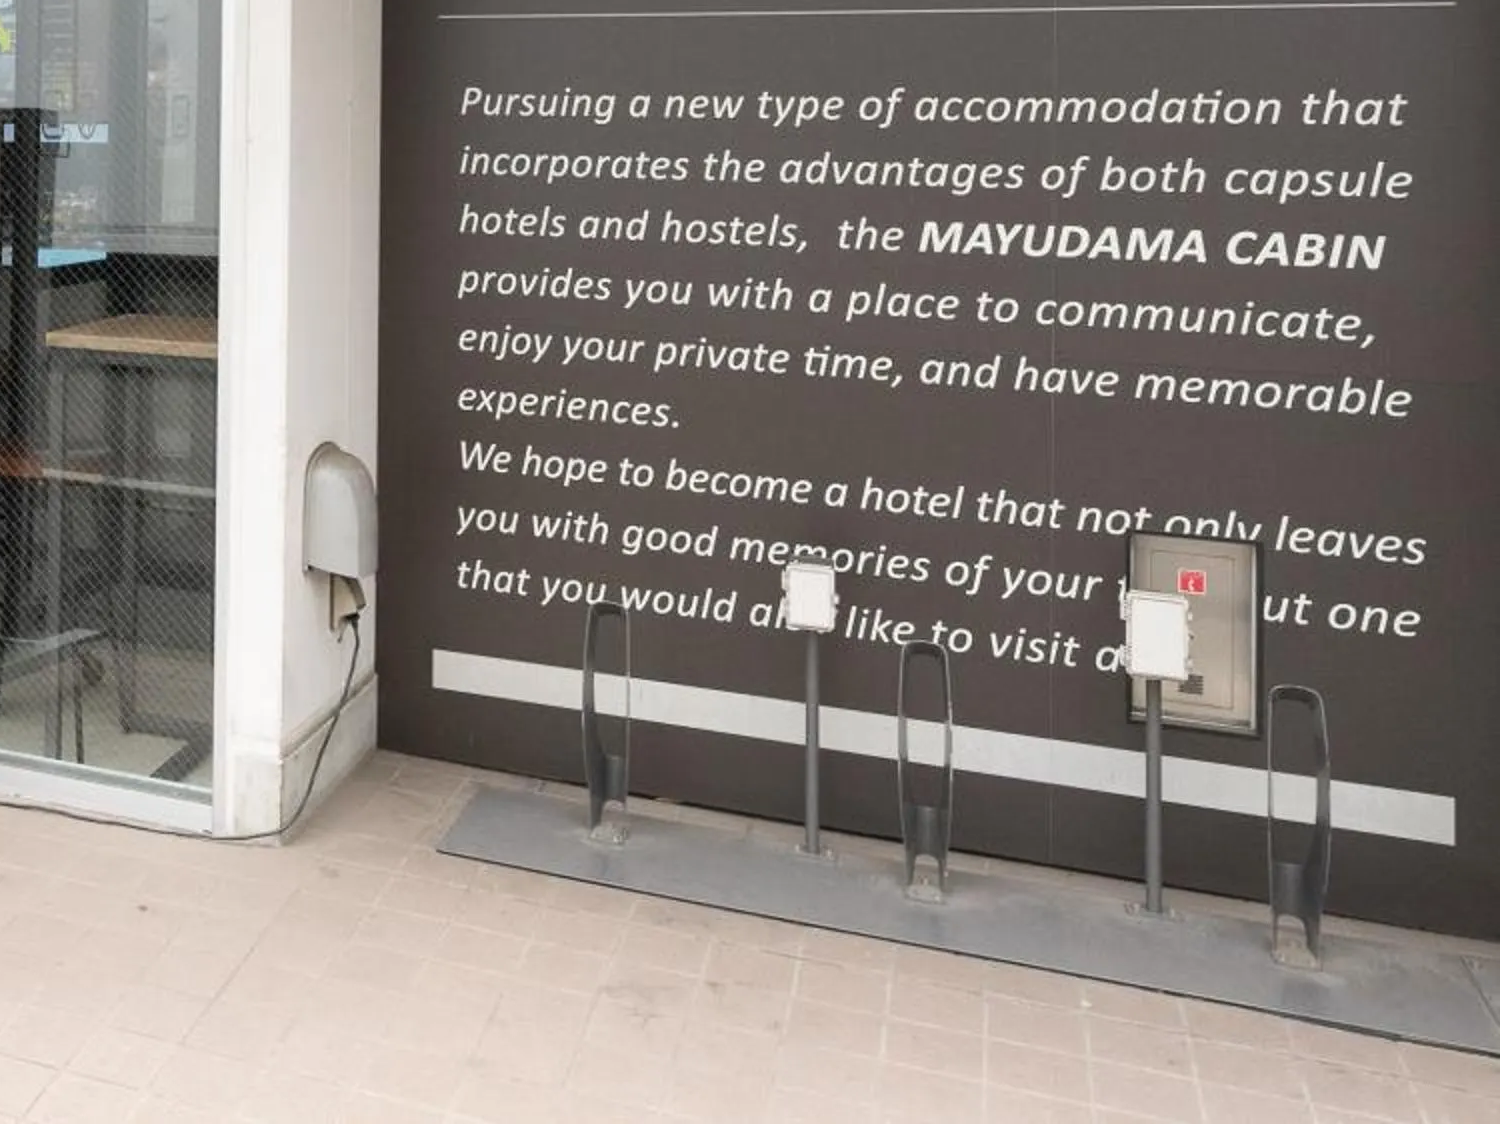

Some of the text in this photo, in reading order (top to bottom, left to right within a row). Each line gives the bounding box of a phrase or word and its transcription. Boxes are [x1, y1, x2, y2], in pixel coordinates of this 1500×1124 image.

[461, 87, 1409, 129] Pursuing a new type of accommodation that
[459, 145, 1413, 205] incorporates the advantages of both capsule
[459, 203, 1387, 270] hotels and hostels, the MAYUDAMA CABIN
[457, 267, 1375, 349] provides you with a place to communicate,
[458, 324, 1413, 417] enjoy your private time, and have memorable
[458, 388, 679, 429] experiences.
[460, 440, 512, 473] We
[521, 444, 608, 487] hope
[619, 457, 655, 487] to
[665, 458, 813, 504] become
[824, 483, 849, 508] a
[860, 476, 965, 519] hotel
[977, 489, 1066, 529] that
[1076, 507, 1153, 535] not
[1275, 515, 1427, 565] leaves
[456, 507, 519, 536] you
[532, 510, 609, 545] with
[621, 525, 719, 557] good
[945, 554, 993, 596] of
[1001, 567, 1104, 601] your
[1263, 593, 1313, 625] ut
[1328, 603, 1421, 637] one
[457, 559, 531, 597] that
[541, 576, 607, 606] you
[621, 585, 738, 623] would
[845, 605, 916, 645] like
[930, 620, 973, 653] to
[989, 627, 1081, 667] visit
